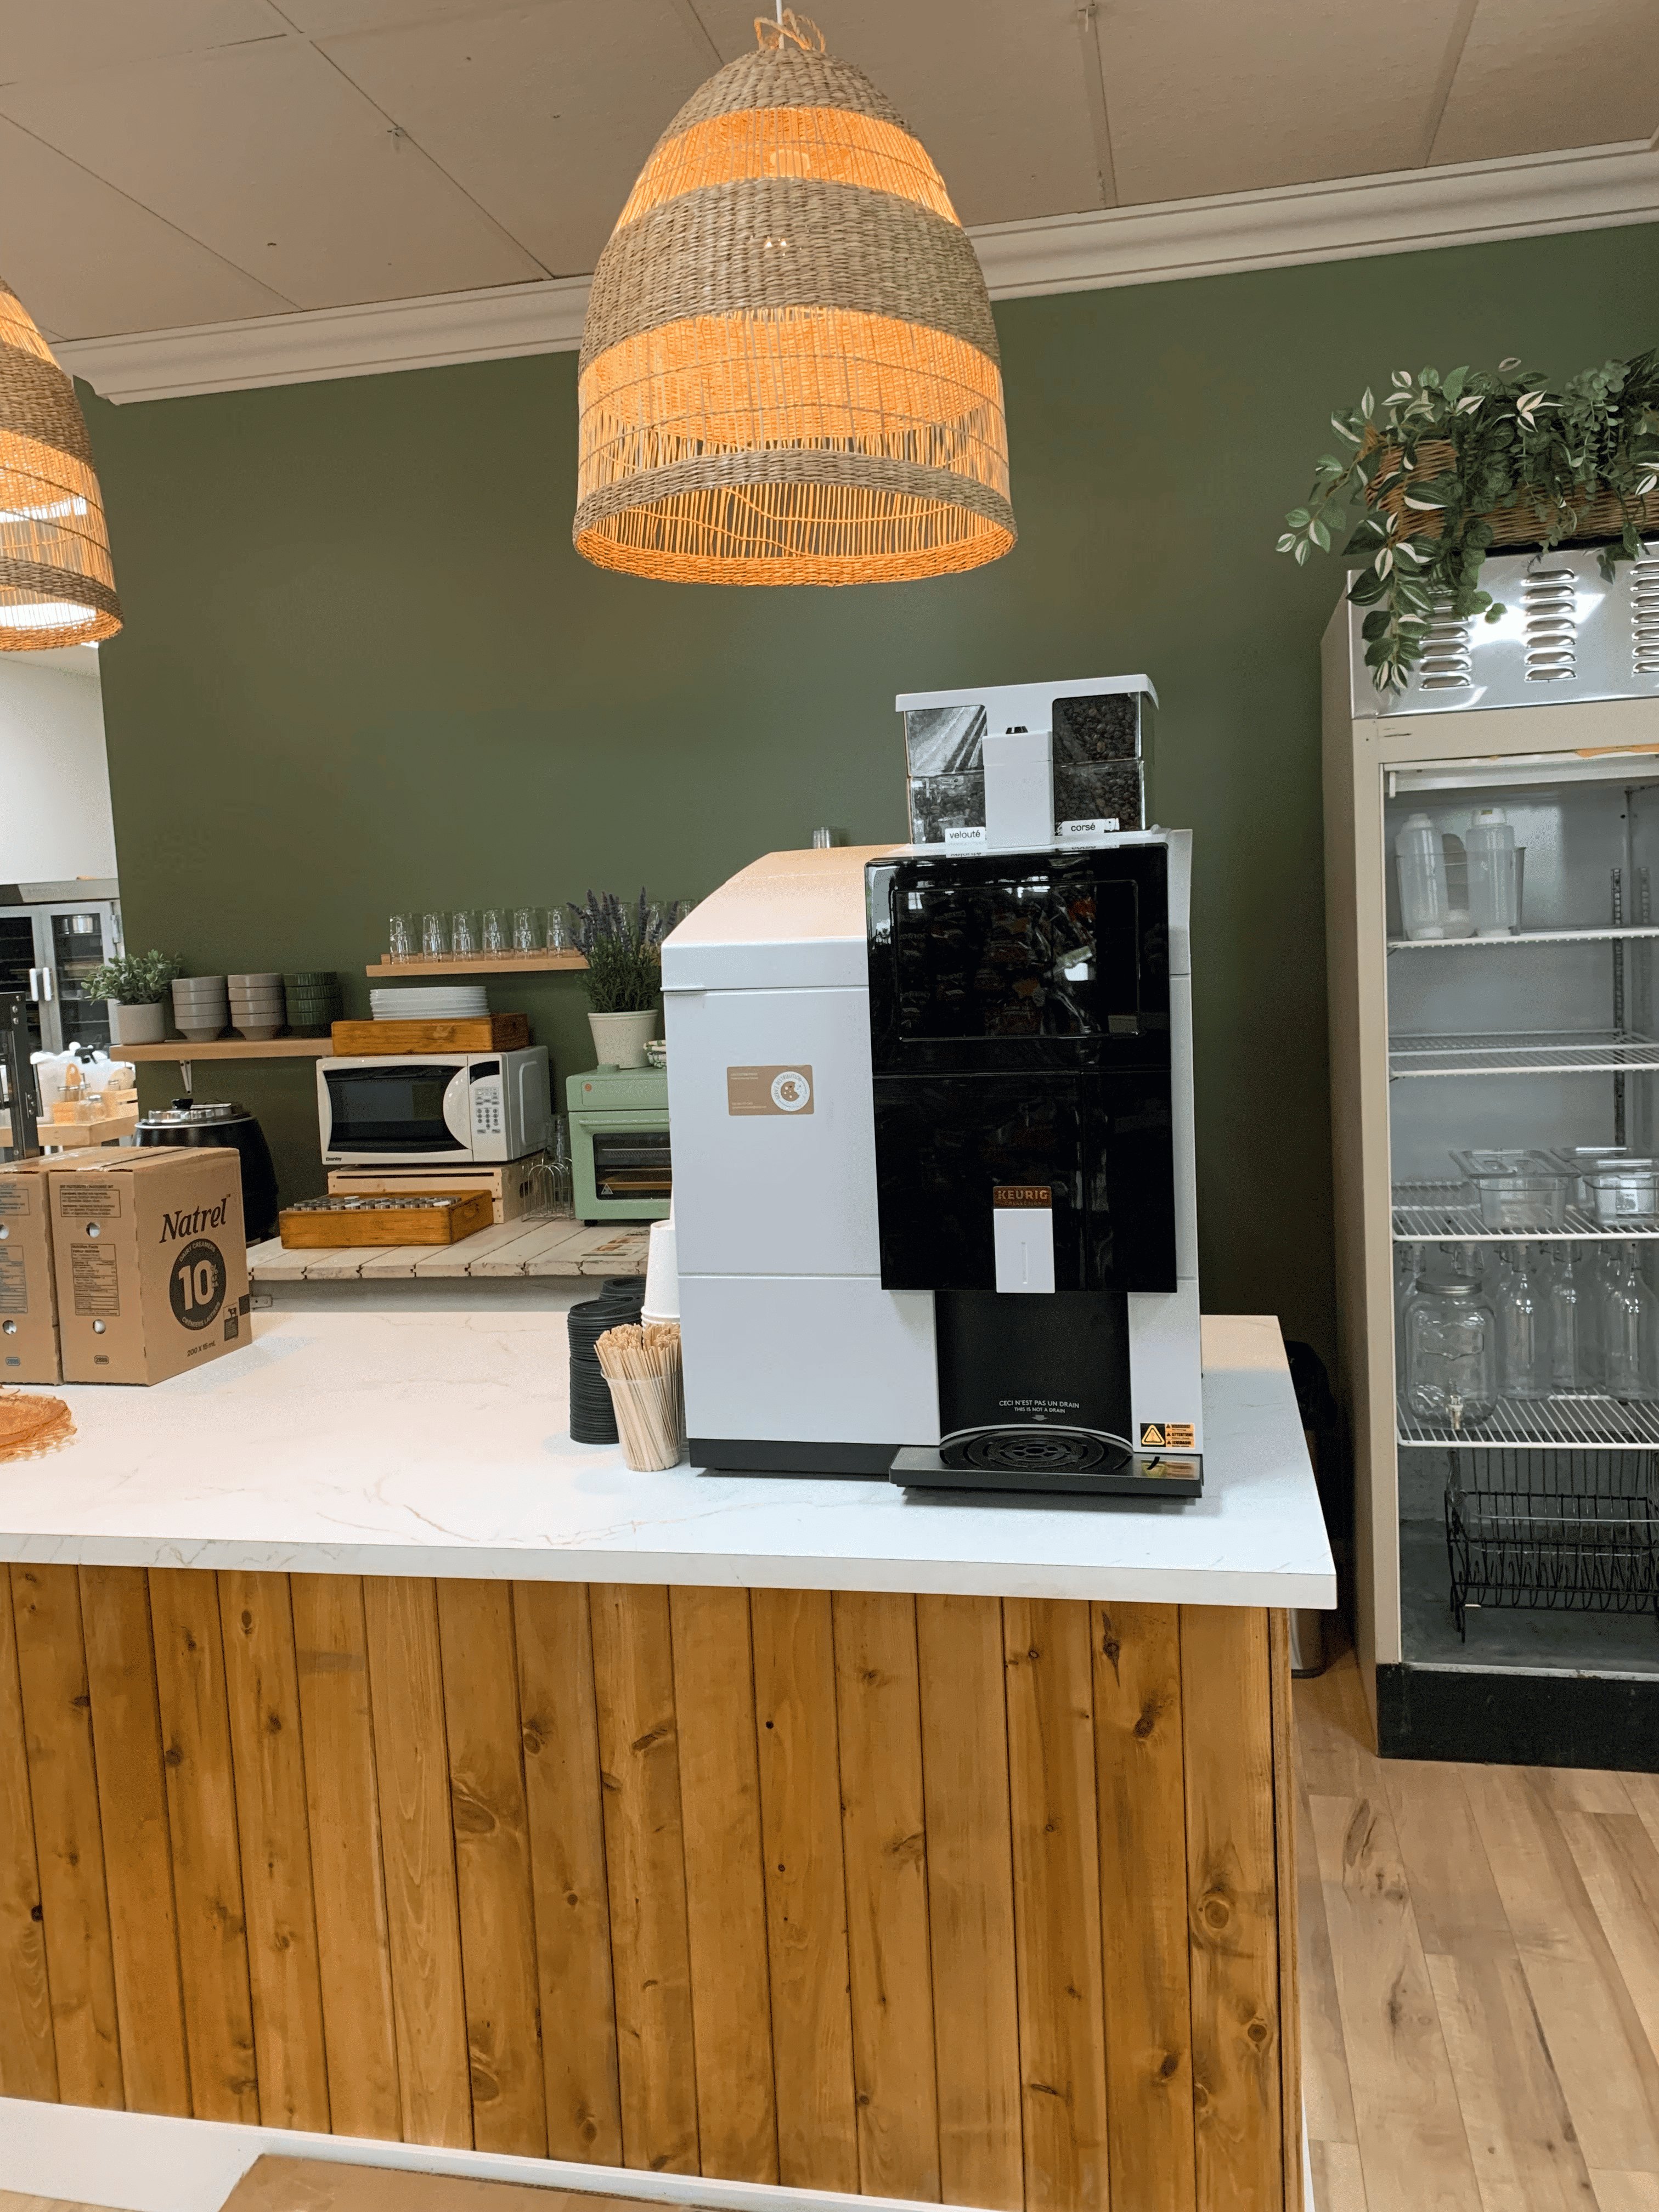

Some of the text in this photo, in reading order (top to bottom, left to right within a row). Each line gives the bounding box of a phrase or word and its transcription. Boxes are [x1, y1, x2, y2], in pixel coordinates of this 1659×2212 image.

[1070, 823, 1096, 832] corsé
[949, 830, 981, 839] velouté
[997, 1190, 1048, 1200] KEURIG
[159, 1198, 227, 1244] Natrel
[178, 1260, 214, 1311] 10
[187, 1347, 198, 1357] 200
